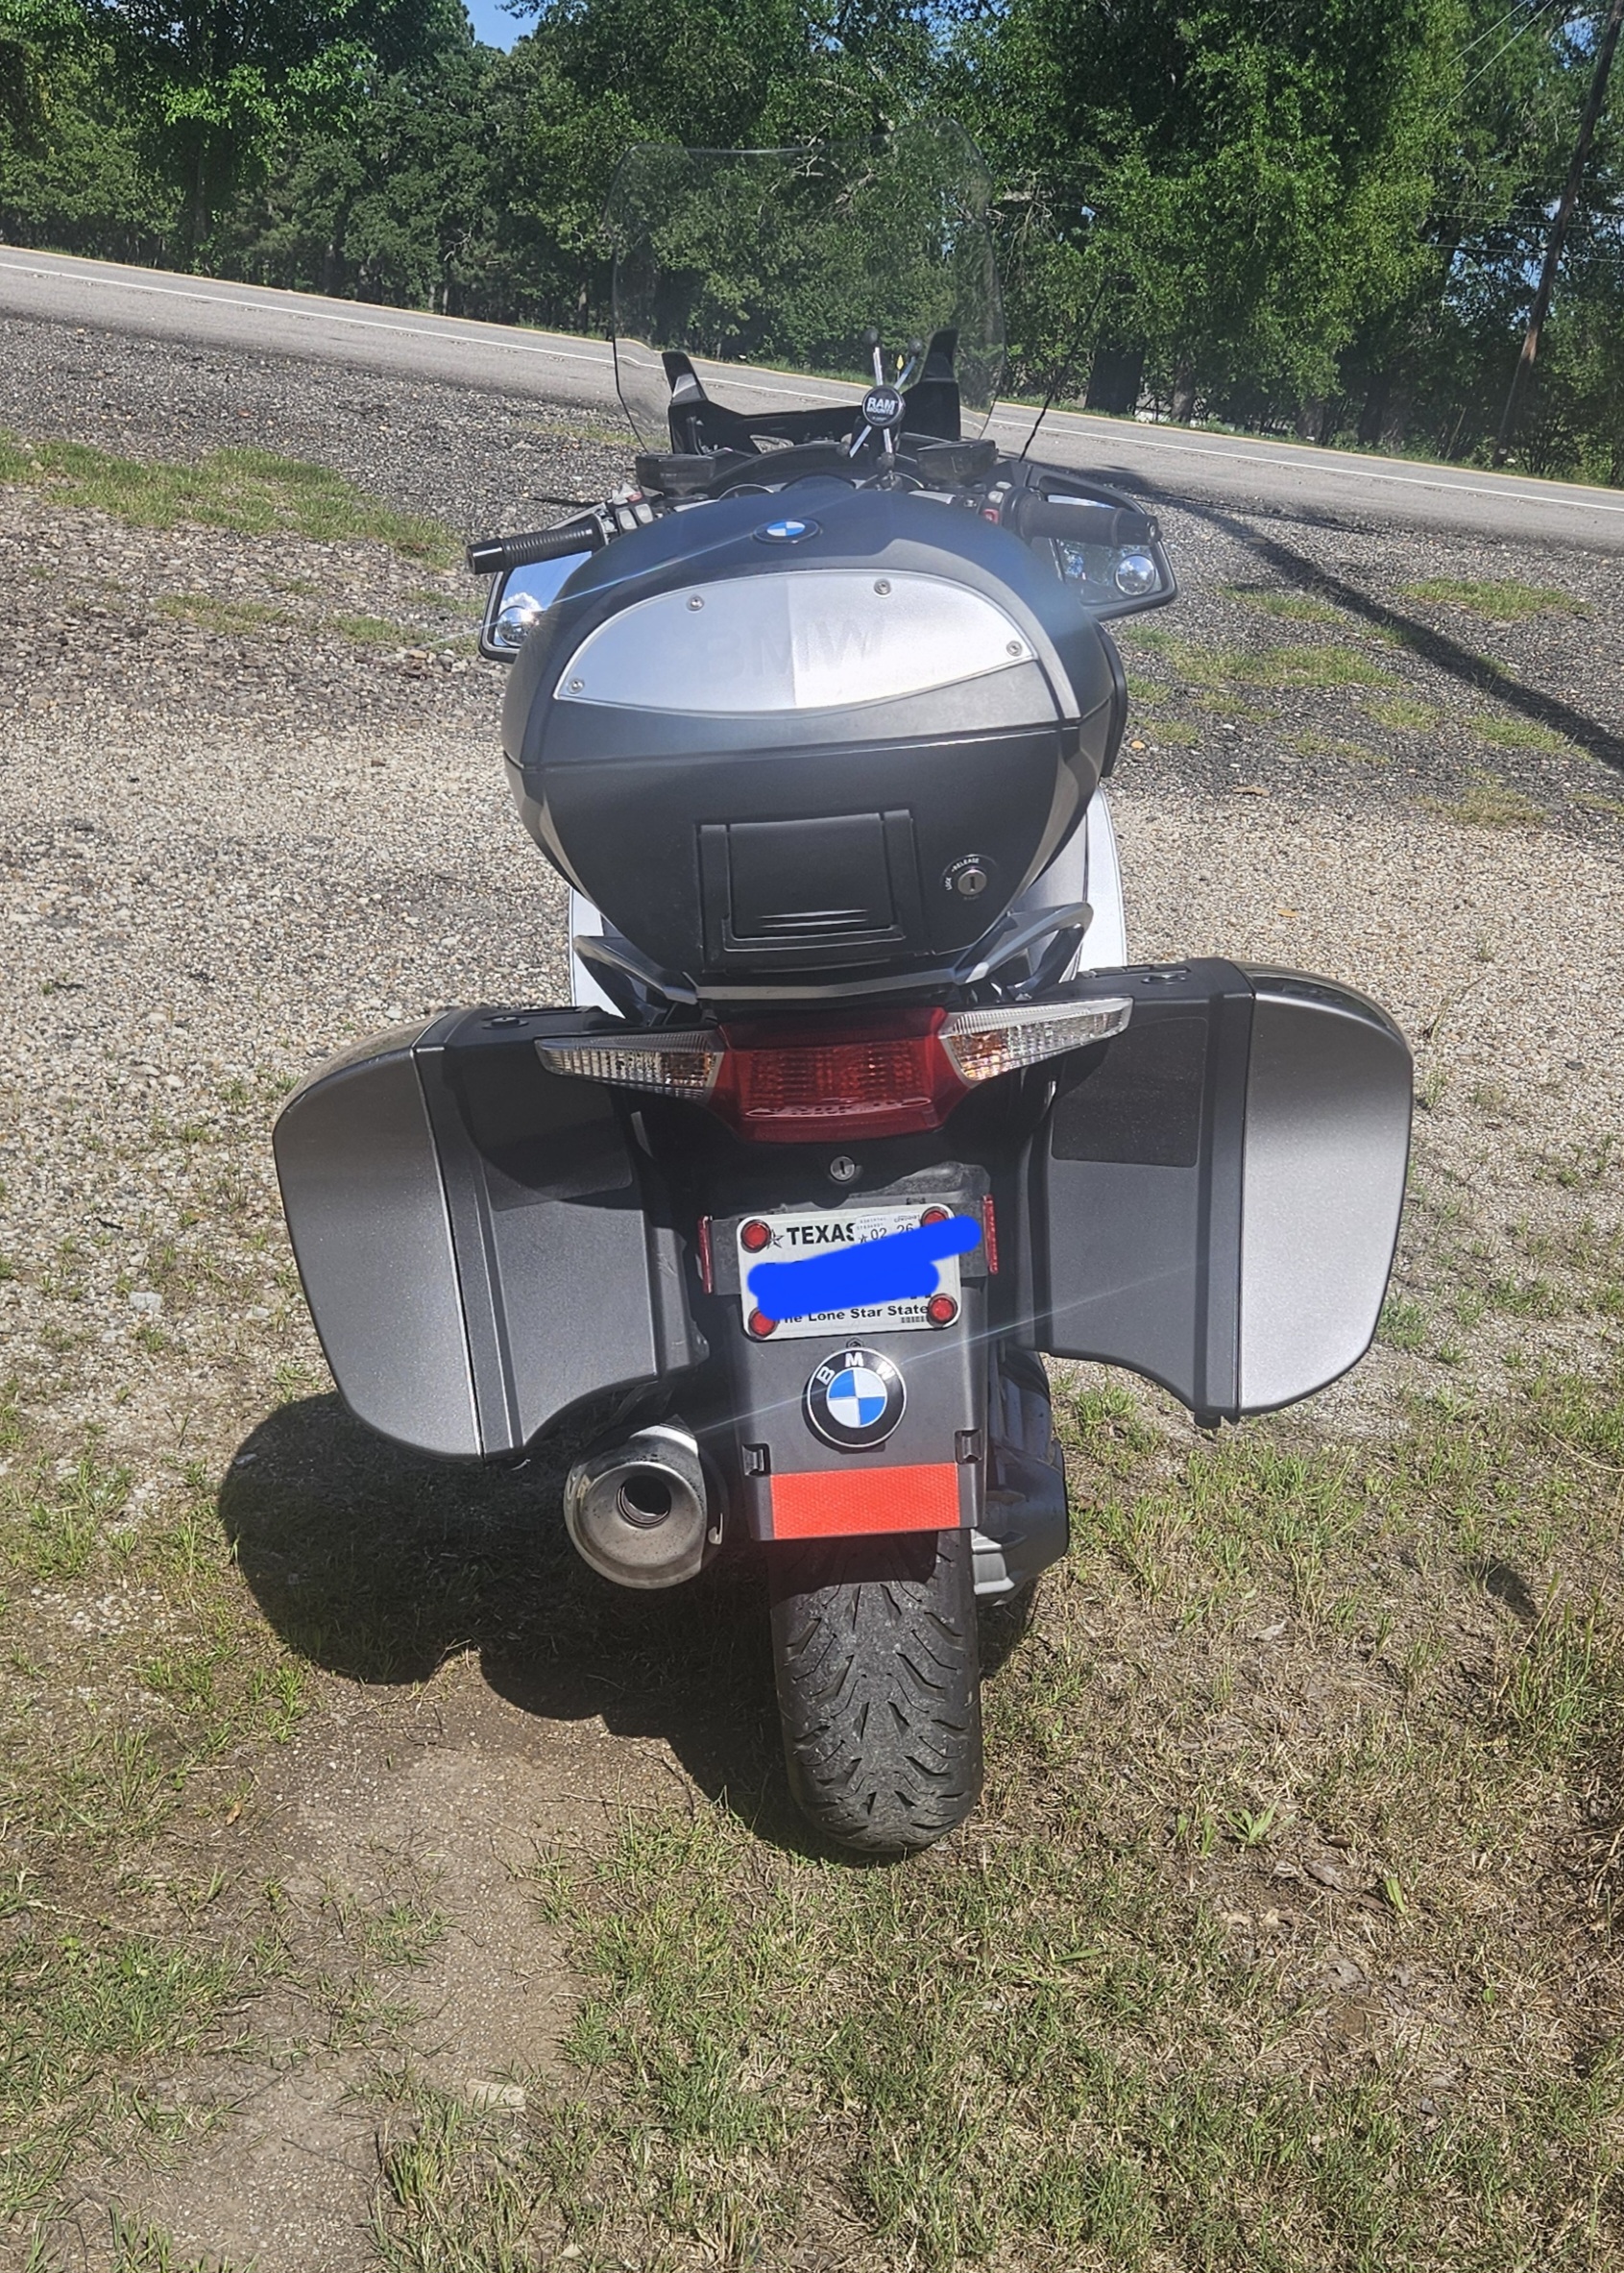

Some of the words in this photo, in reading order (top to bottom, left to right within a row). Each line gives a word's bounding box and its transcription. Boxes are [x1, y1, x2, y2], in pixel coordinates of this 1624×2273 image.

[867, 397, 896, 410] RAM
[700, 617, 885, 682] BMW
[787, 1223, 856, 1245] TEXAS
[870, 1227, 887, 1241] 02
[778, 1315, 803, 1324] he
[808, 1311, 845, 1322] Lone
[850, 1308, 884, 1319] Star
[887, 1305, 928, 1317] State
[816, 1352, 896, 1386] BMW
